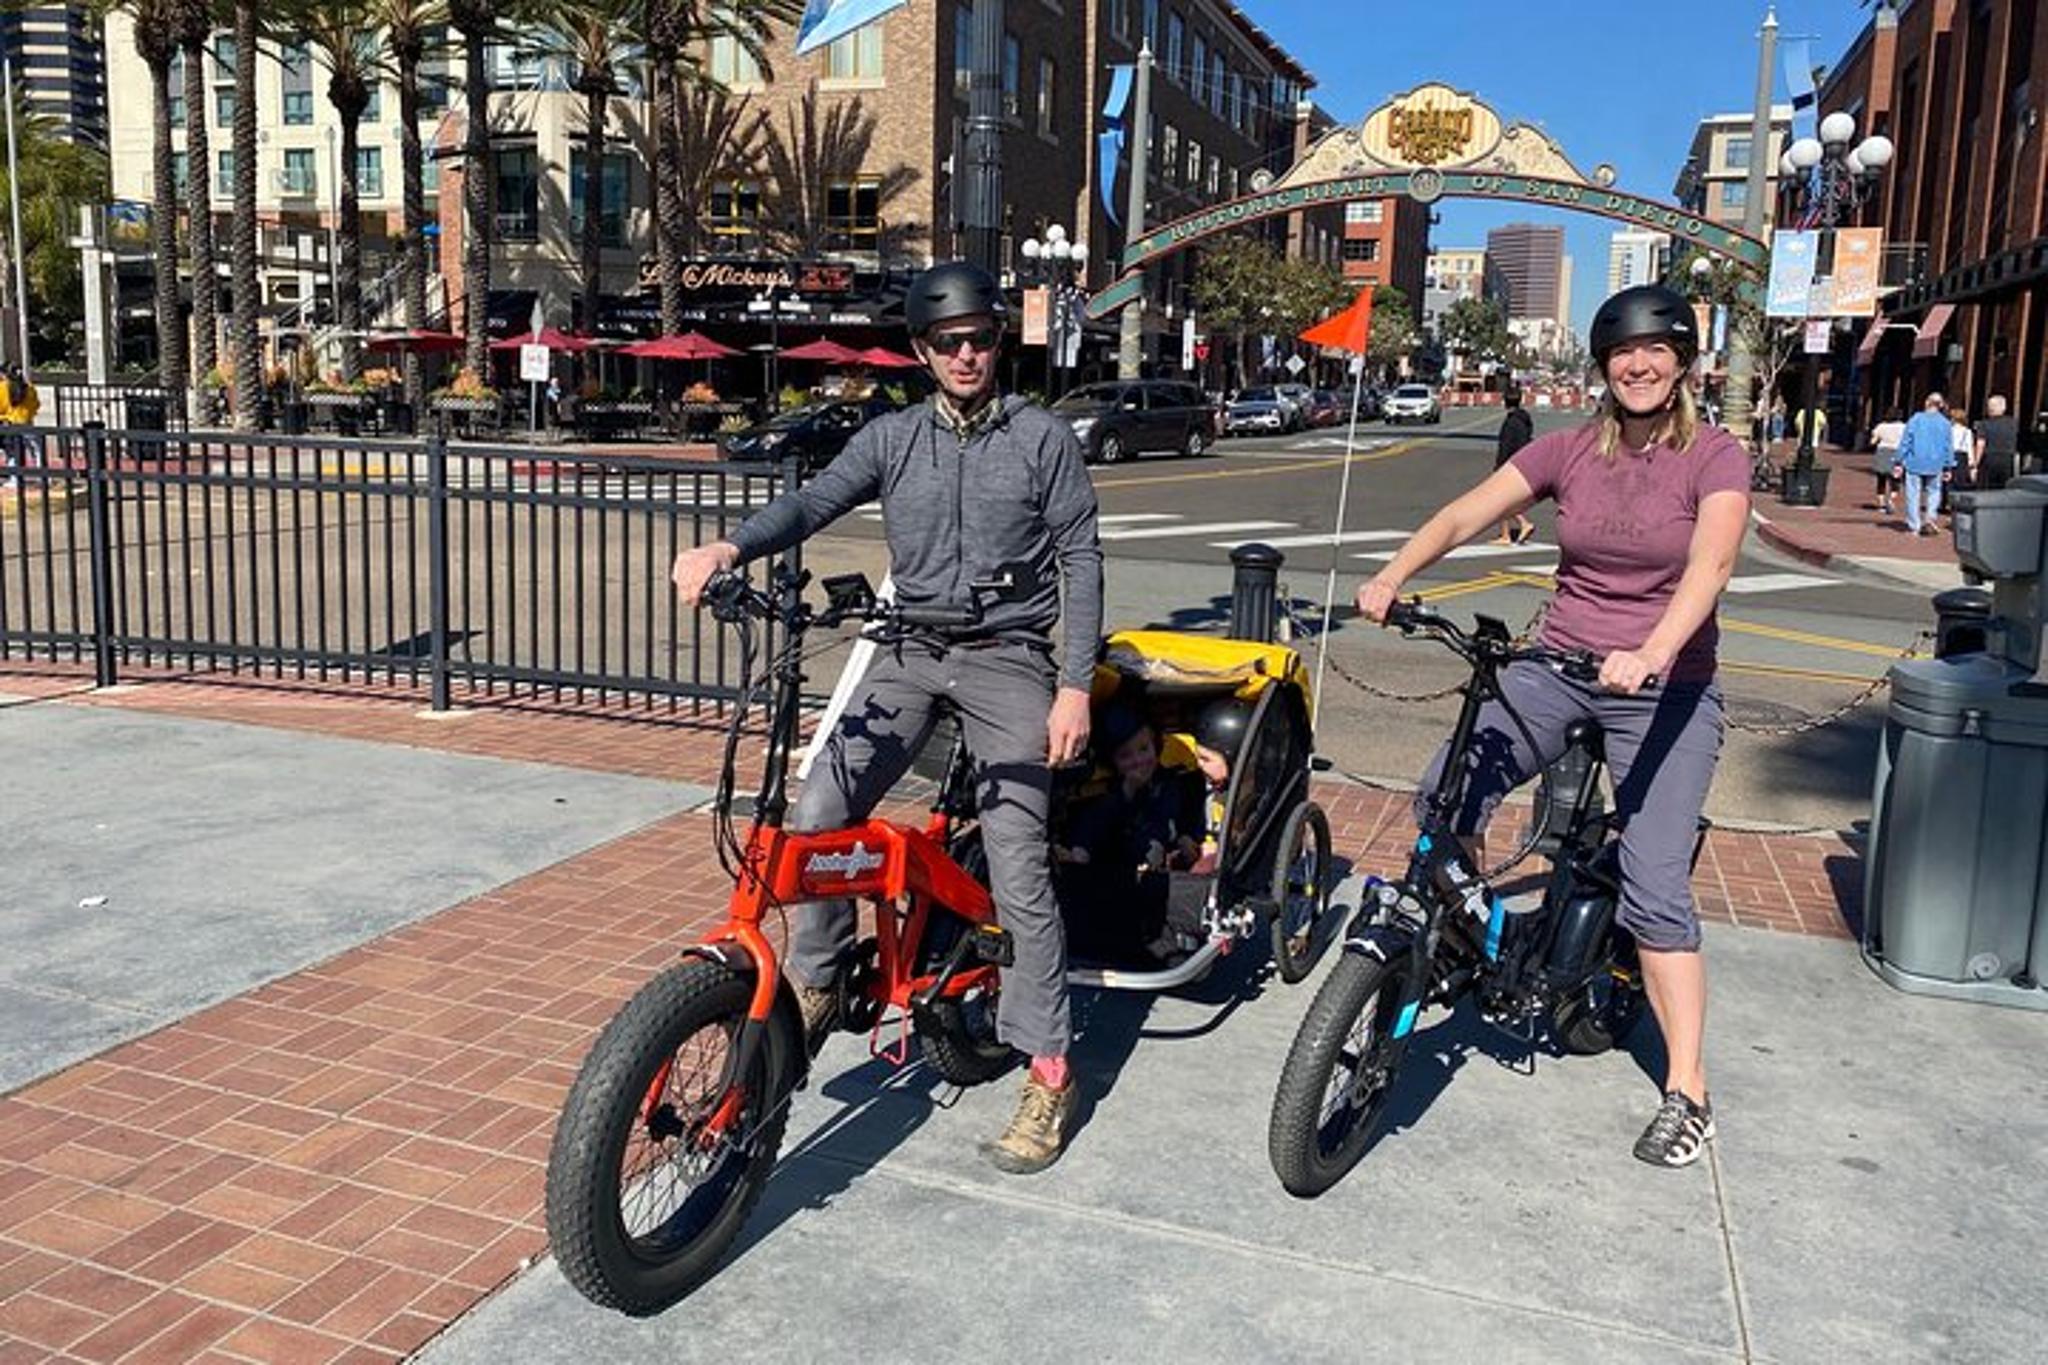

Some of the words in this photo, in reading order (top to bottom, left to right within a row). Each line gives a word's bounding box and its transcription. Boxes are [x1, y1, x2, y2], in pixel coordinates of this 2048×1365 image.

[1171, 191, 1290, 240] HISTORIC
[1304, 176, 1388, 200] HEART
[1472, 175, 1505, 191] OF
[1526, 181, 1583, 200] SAN
[1606, 195, 1702, 234] DIEGO
[700, 264, 794, 297] Mickey's
